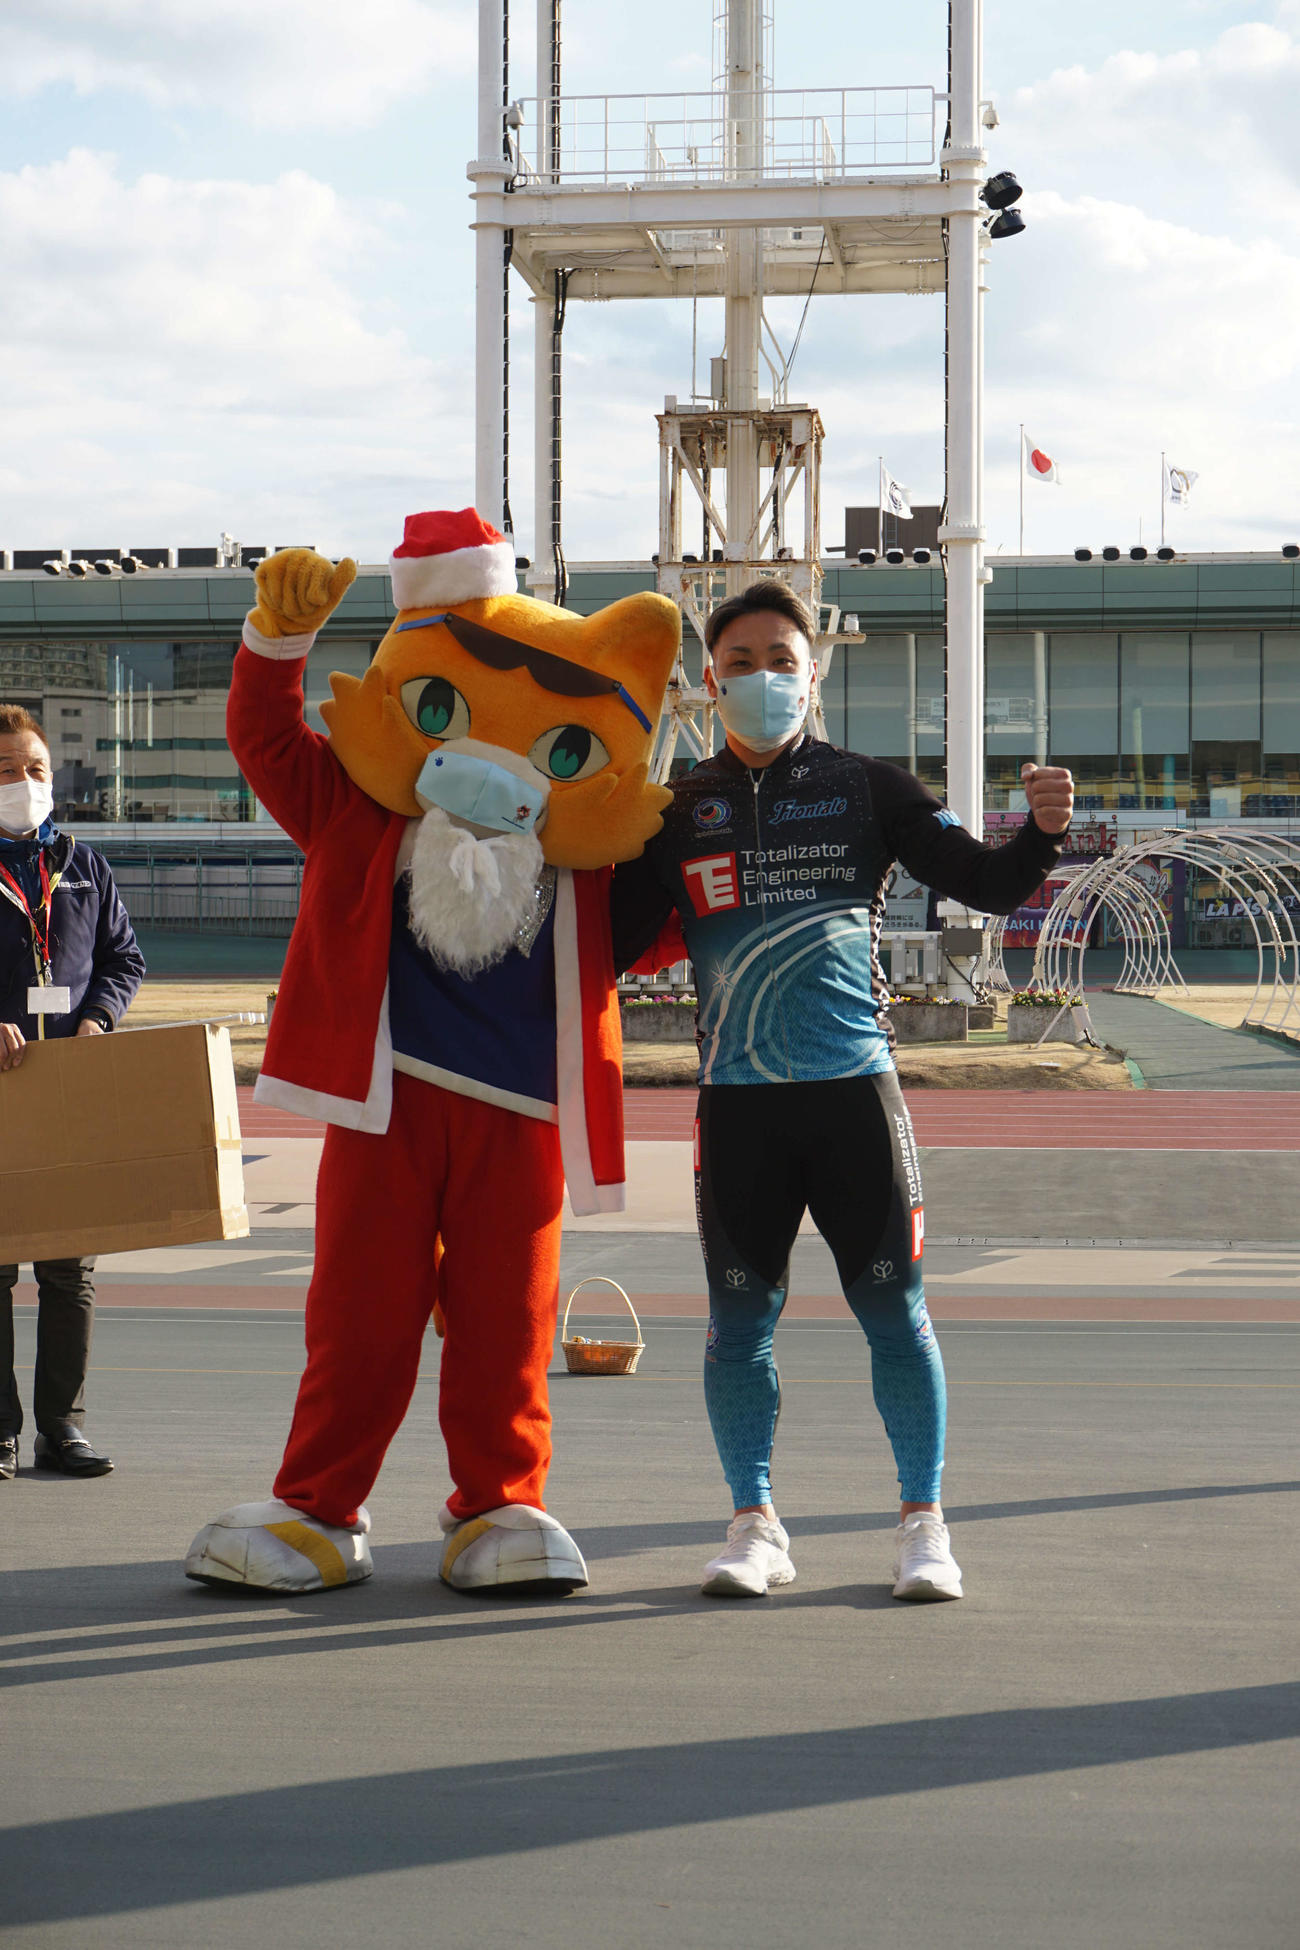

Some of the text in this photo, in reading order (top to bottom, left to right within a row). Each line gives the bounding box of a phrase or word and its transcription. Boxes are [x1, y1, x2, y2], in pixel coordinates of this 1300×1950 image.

[768, 797, 848, 825] Frontale
[740, 843, 850, 864] Totalizator
[743, 864, 857, 886] Engineering
[744, 886, 817, 906] Limited
[894, 1113, 918, 1206] Totalizator
